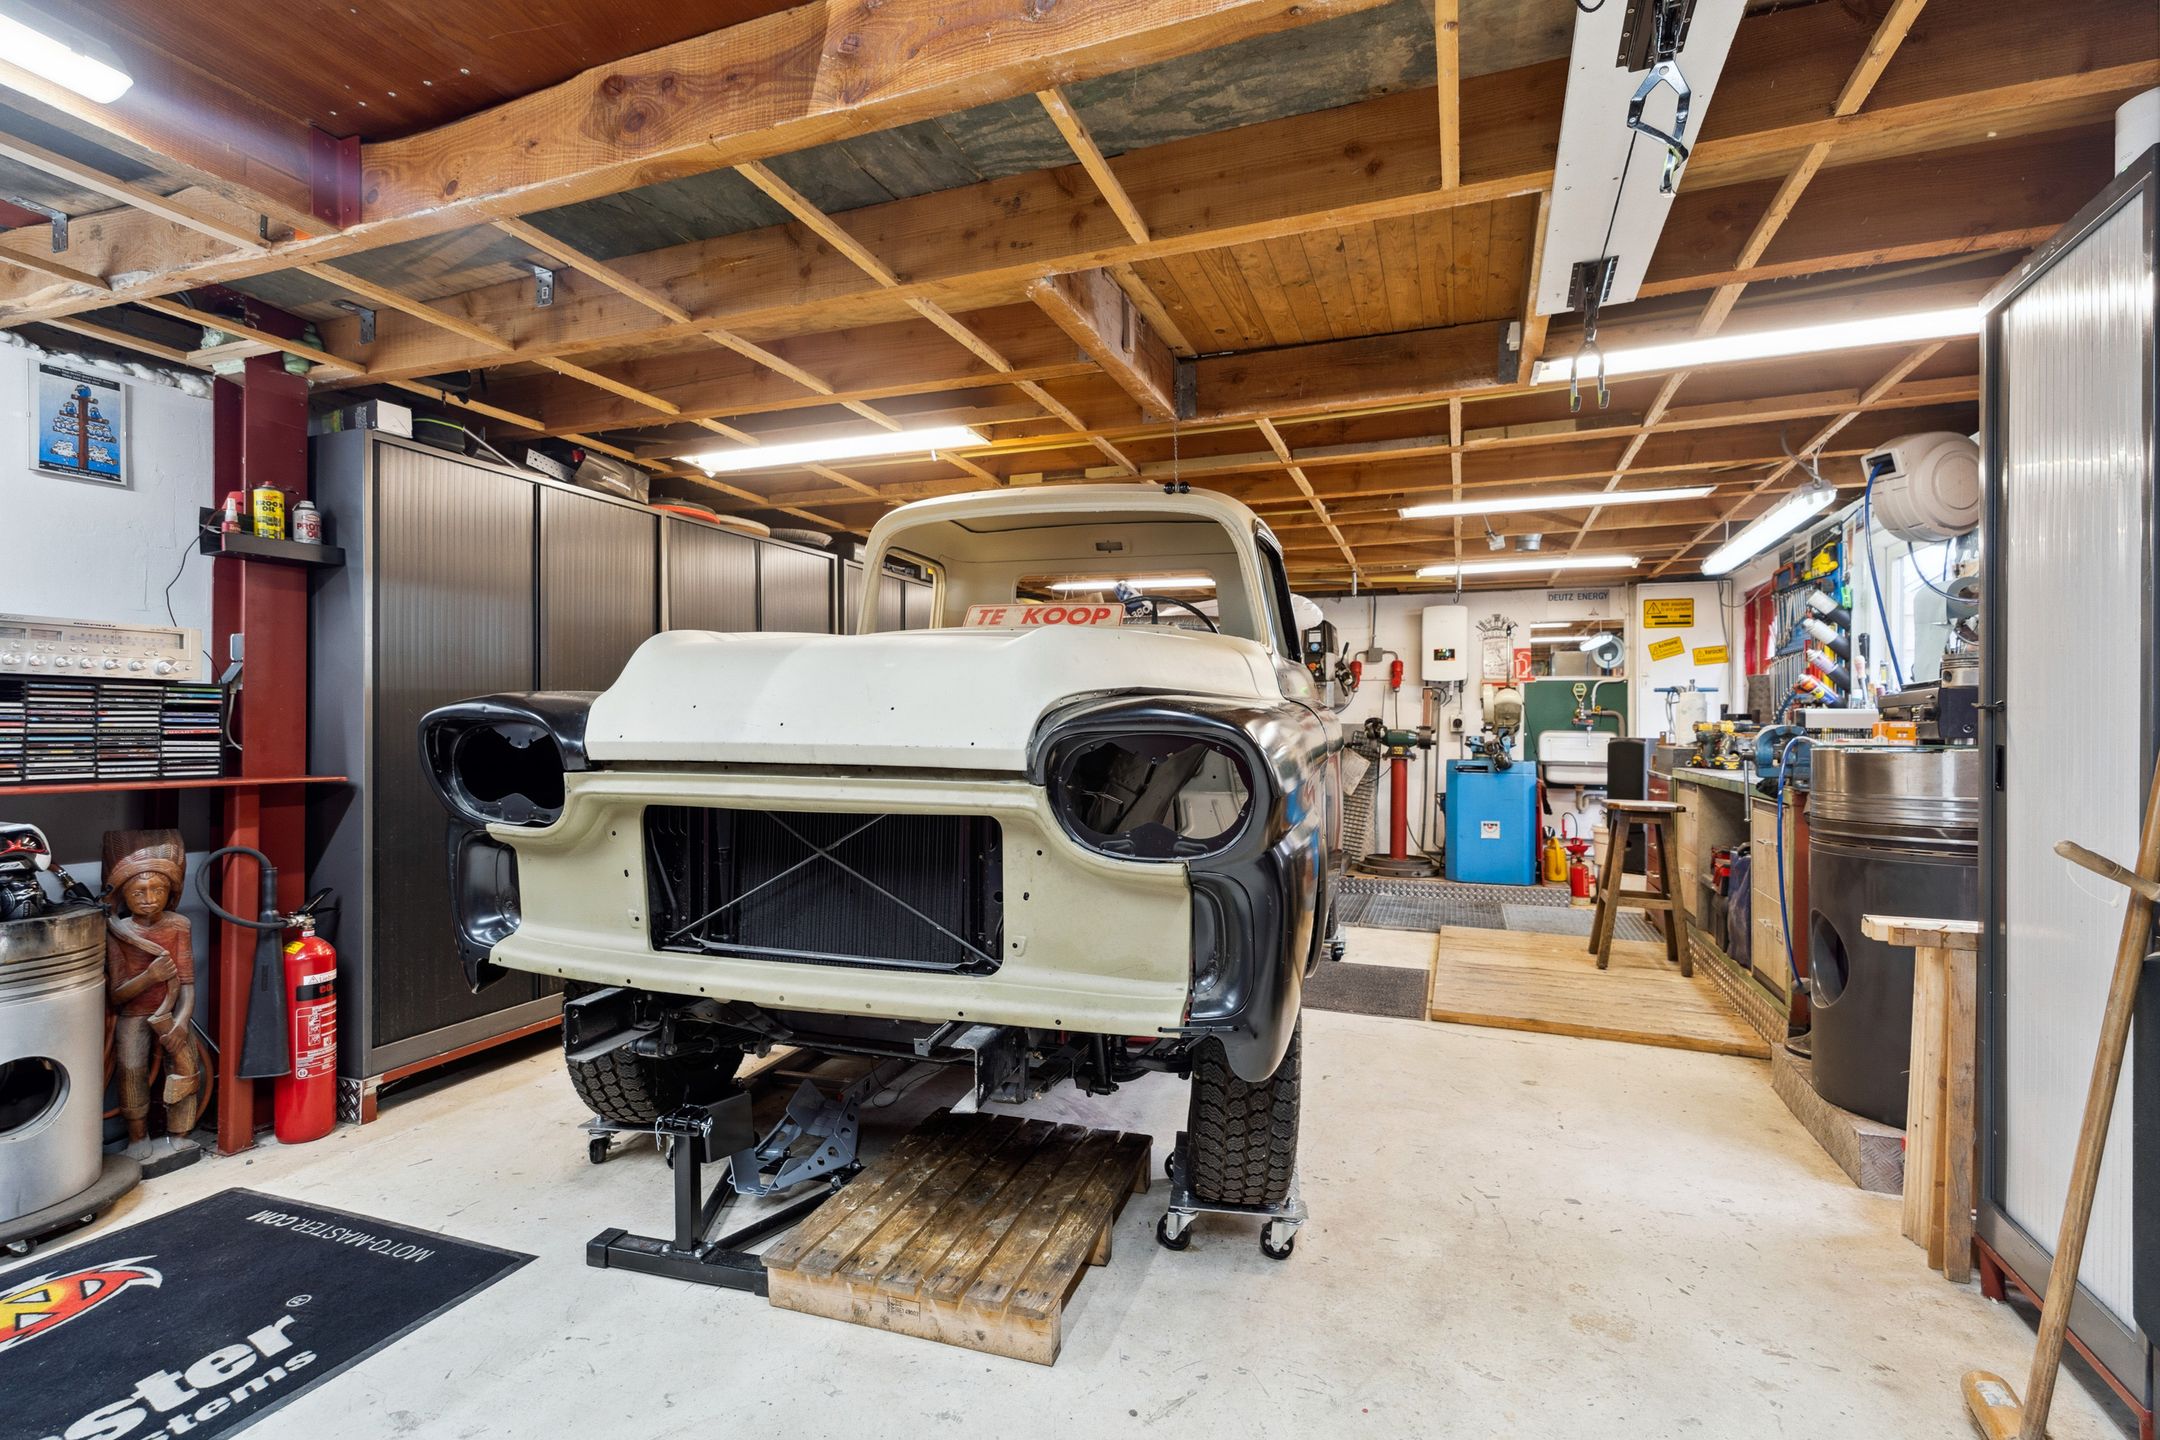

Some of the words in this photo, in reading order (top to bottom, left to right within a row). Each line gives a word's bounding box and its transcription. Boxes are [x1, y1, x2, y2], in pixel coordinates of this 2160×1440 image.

[1548, 593, 1574, 602] DEUTZ
[1577, 591, 1608, 601] ENERGY
[977, 608, 1007, 625] TE
[1021, 607, 1111, 625] KOOP
[246, 1209, 436, 1263] MOTO-MASTER.COM
[40, 1314, 296, 1440] ster
